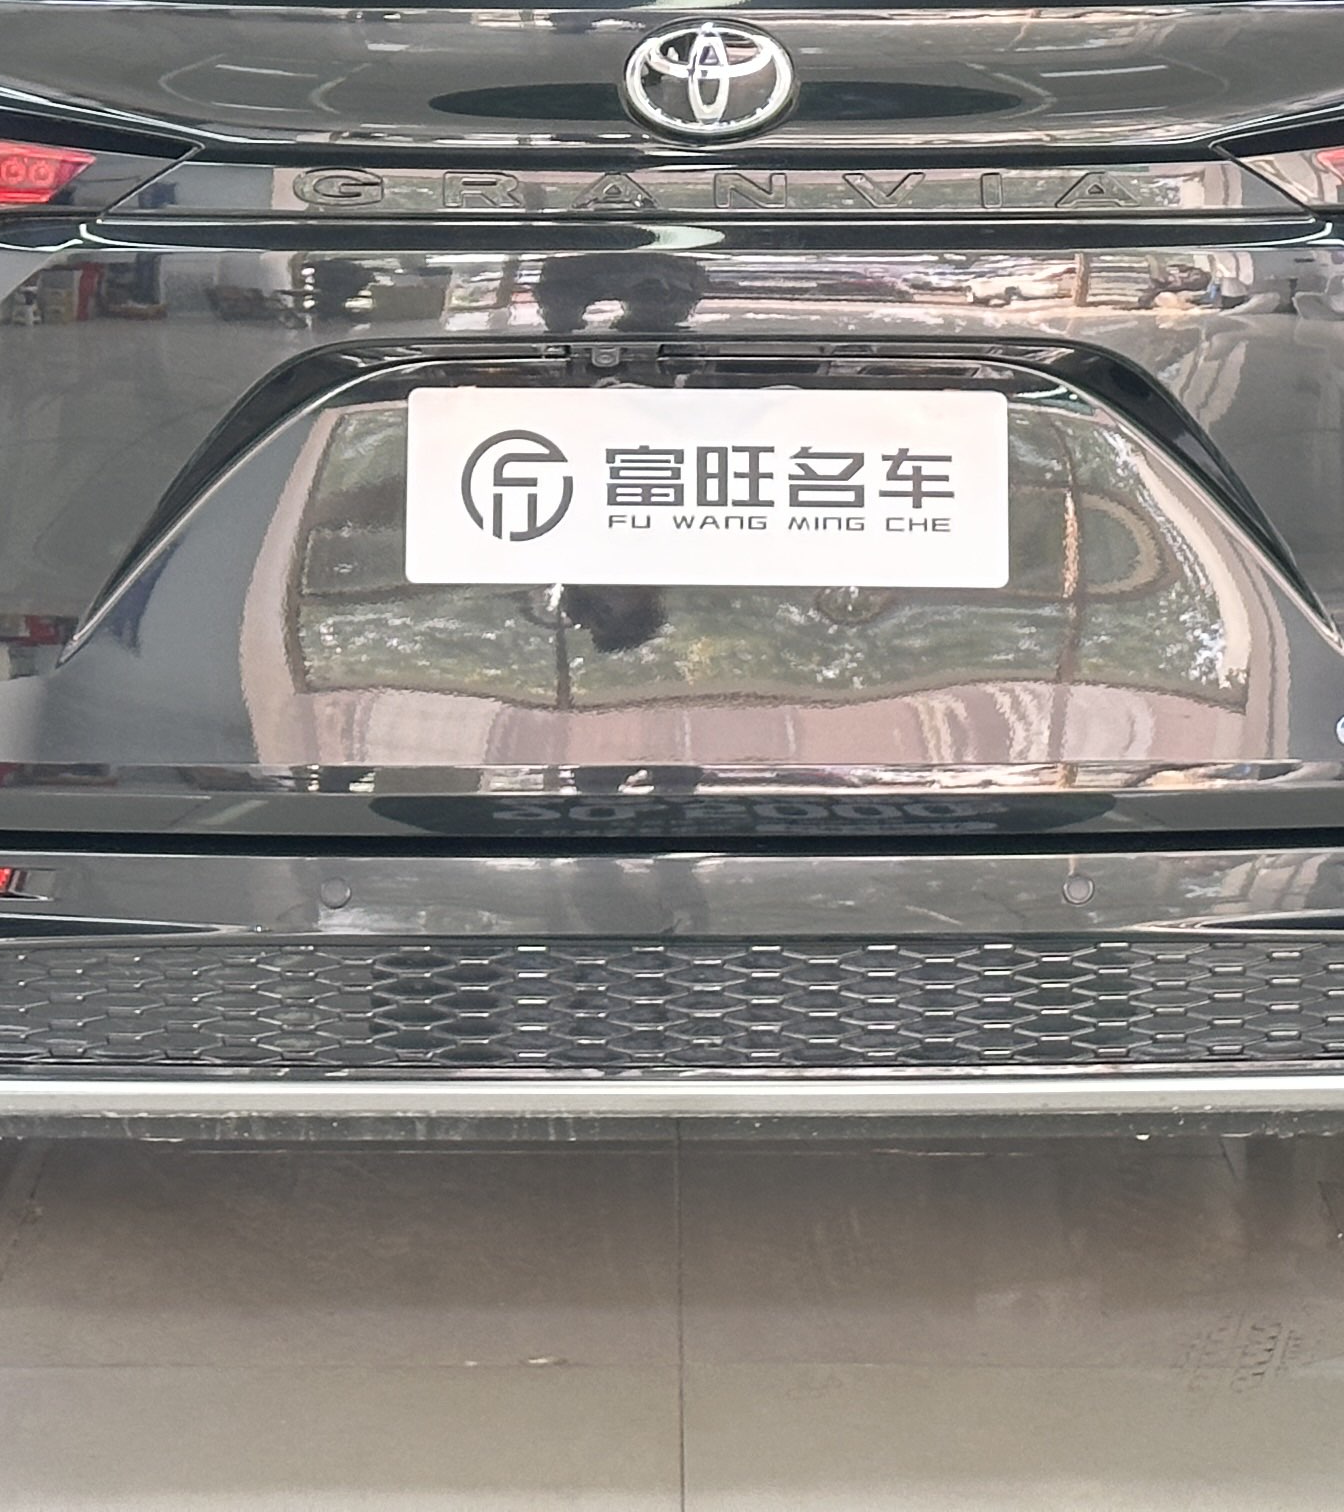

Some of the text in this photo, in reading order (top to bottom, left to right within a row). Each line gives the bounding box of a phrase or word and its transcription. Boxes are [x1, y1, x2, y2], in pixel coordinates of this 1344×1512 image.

[292, 166, 1143, 210] GRANVIA
[605, 444, 955, 509] 富旺名车
[608, 514, 951, 533] FU WANG MING CHE
